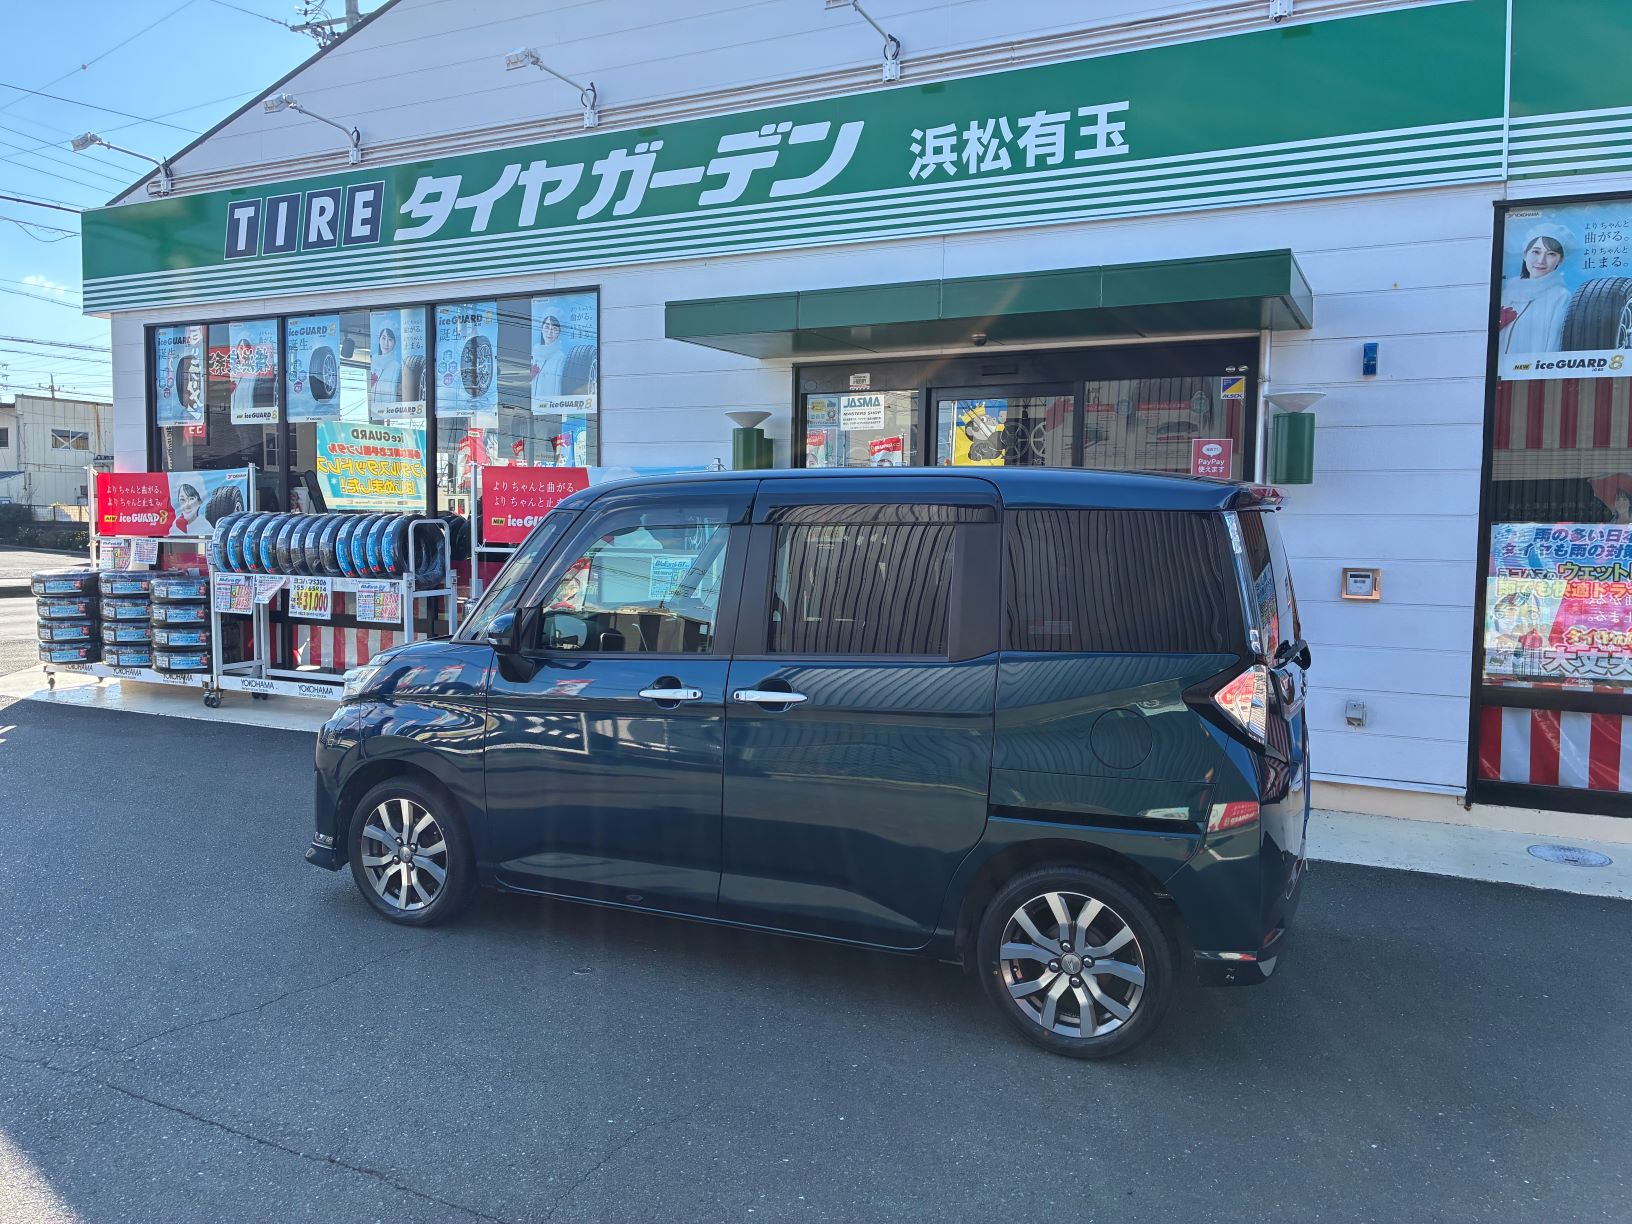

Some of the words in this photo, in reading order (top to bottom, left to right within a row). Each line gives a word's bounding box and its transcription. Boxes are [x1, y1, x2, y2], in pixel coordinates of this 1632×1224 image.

[394, 121, 864, 241] タイヤガーデン
[909, 100, 1130, 180] 浜松有玉
[234, 190, 375, 250] TIRE
[1584, 220, 1629, 230] よりちゃんと
[1584, 231, 1629, 244] 曲がる。
[1584, 246, 1628, 255] よりちゃんと
[1584, 256, 1629, 269] 止まる。
[288, 326, 327, 336] iceGUARD
[1535, 359, 1607, 370] iceGUARD
[549, 401, 585, 409] iceGUARD
[844, 396, 881, 408] JASMA
[119, 512, 160, 523] iceGUARD
[112, 667, 142, 676] YOKOHAMA
[240, 679, 275, 690] YOKOHAMA
[297, 684, 334, 695] YOKOHAMA
